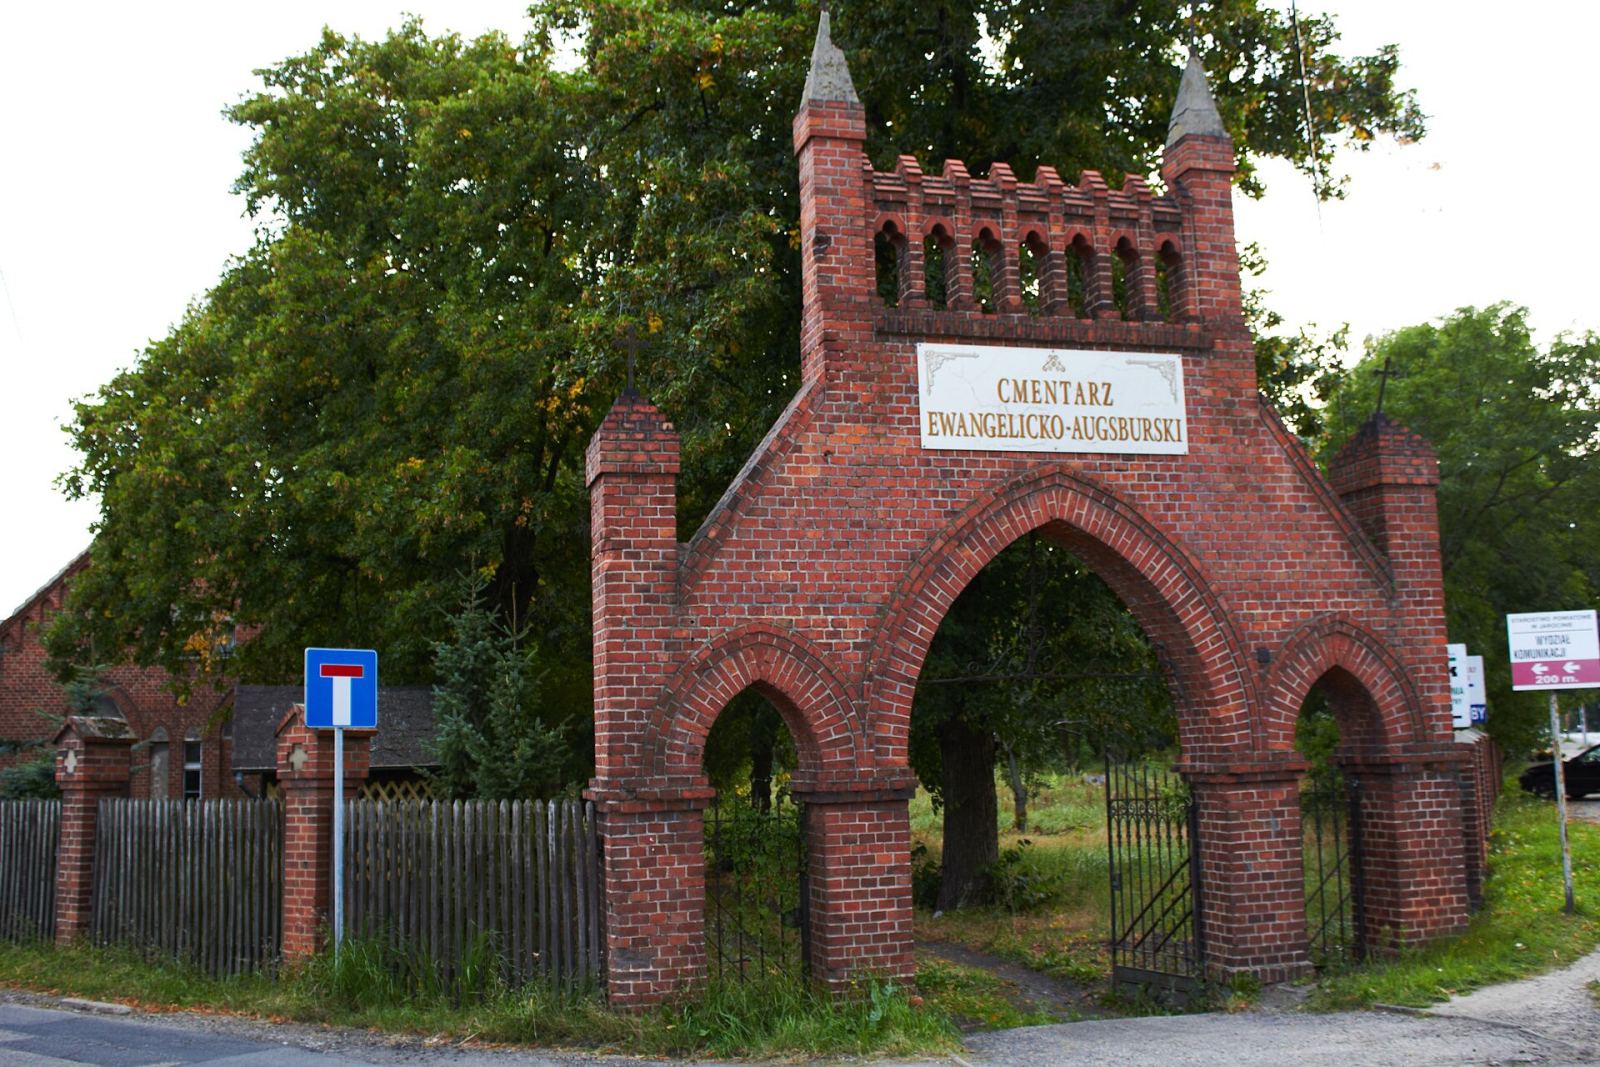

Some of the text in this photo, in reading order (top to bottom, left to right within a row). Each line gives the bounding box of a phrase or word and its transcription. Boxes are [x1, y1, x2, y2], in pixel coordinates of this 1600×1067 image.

[997, 378, 1113, 406] CMENTARZ
[927, 411, 1183, 442] EWANGELICKO-AUGSBURSKI
[1535, 635, 1571, 645] WYDZIAŁ
[1514, 648, 1566, 659] KOMUNIKACJI
[1535, 675, 1579, 684] 200 m.
